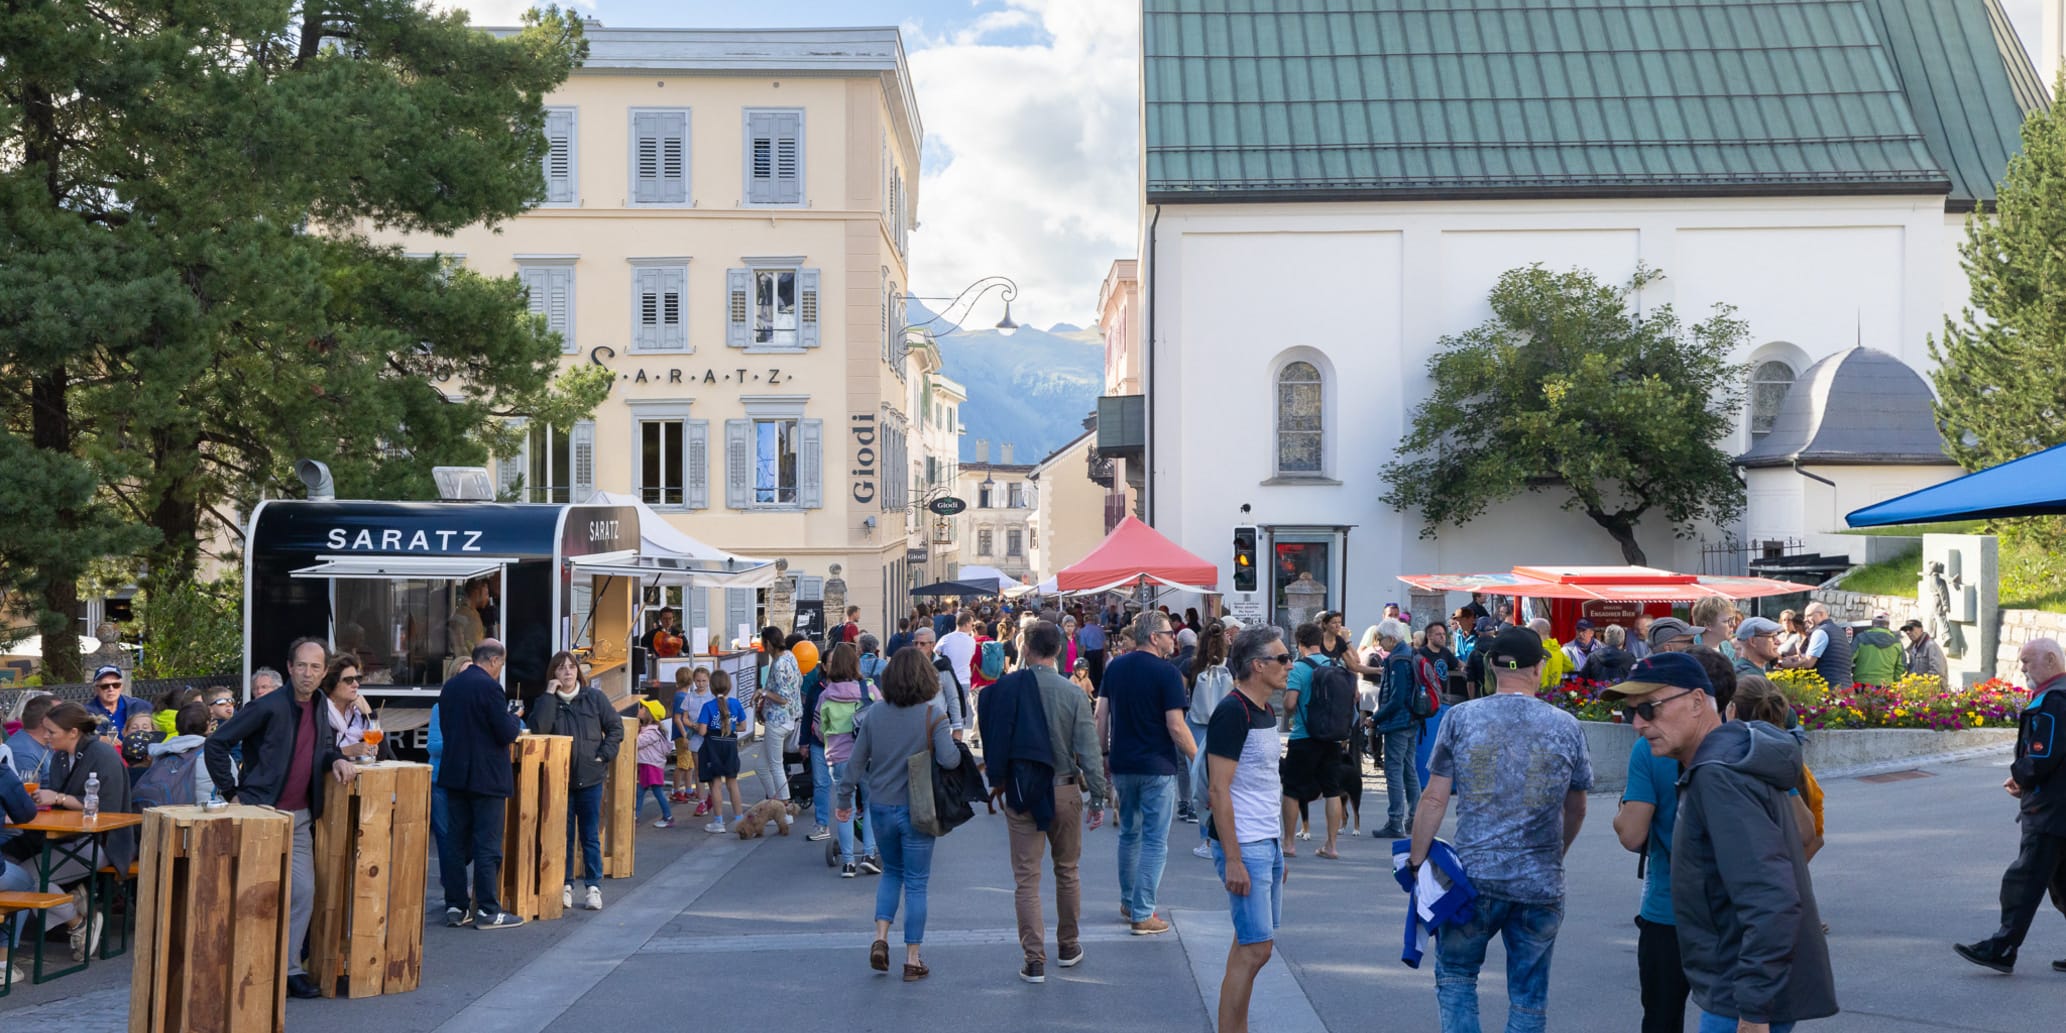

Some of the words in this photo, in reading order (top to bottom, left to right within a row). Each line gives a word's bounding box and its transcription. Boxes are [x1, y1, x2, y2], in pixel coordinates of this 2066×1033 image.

[852, 413, 875, 504] Giodi
[937, 501, 958, 509] Giodi
[326, 527, 483, 551] SARATZ
[589, 520, 619, 542] SARATZ
[908, 551, 927, 560] Giodi
